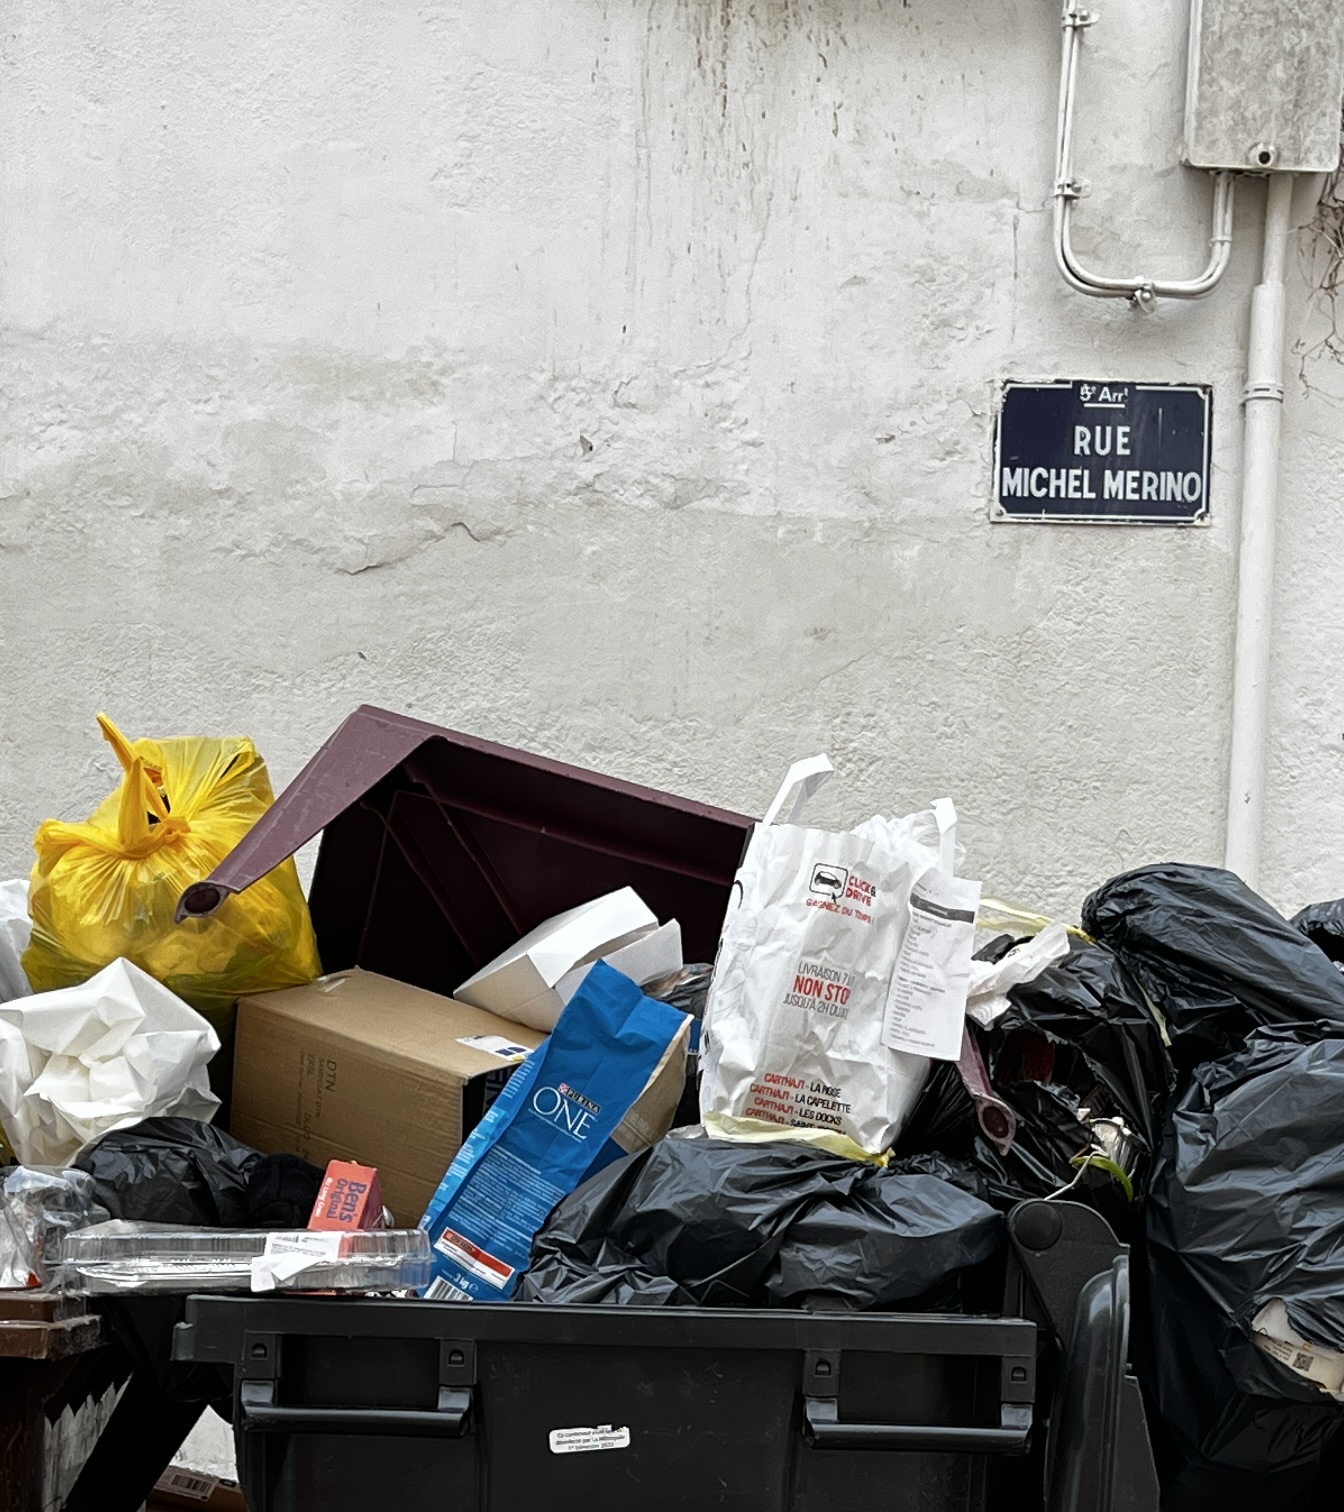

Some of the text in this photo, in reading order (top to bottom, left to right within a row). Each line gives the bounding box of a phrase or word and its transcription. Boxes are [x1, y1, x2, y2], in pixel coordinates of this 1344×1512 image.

[1074, 425, 1131, 456] RUE
[1002, 466, 1202, 503] MICHEL MERINO
[845, 887, 872, 907] DRIVE
[841, 906, 853, 916] DU
[797, 962, 841, 983] LIVRAISON
[793, 975, 824, 998] NON
[567, 1089, 600, 1113] PURINA
[810, 1082, 821, 1093] LA
[822, 1084, 841, 1098] ROSE
[533, 1086, 596, 1140] ONE
[795, 1093, 805, 1104] LA
[807, 1096, 851, 1113] CAPELETTE
[799, 1108, 814, 1119] LES
[815, 1110, 842, 1125] DOCKS
[339, 1180, 367, 1222] Ben's
